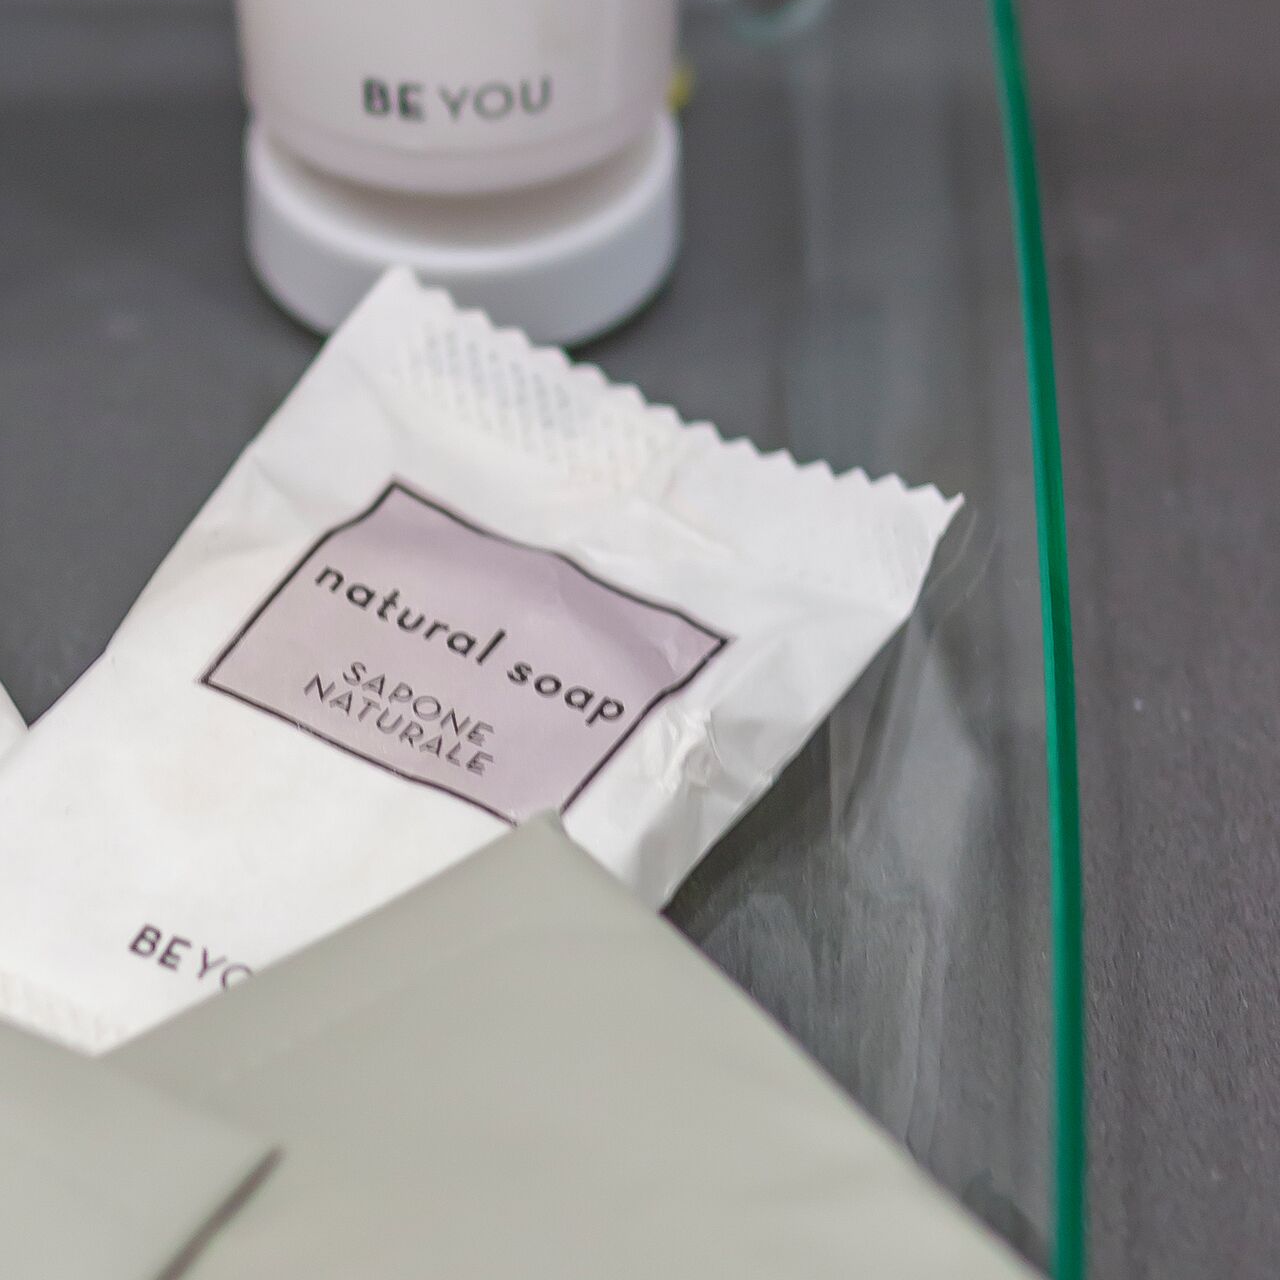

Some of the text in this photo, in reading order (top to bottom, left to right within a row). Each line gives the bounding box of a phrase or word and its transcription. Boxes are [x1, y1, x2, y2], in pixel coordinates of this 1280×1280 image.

[363, 75, 553, 122] BE YOU
[315, 565, 624, 727] natural soap
[304, 672, 494, 775] NATURALE
[342, 661, 494, 746] SAPONE
[129, 924, 253, 991] BE YO
